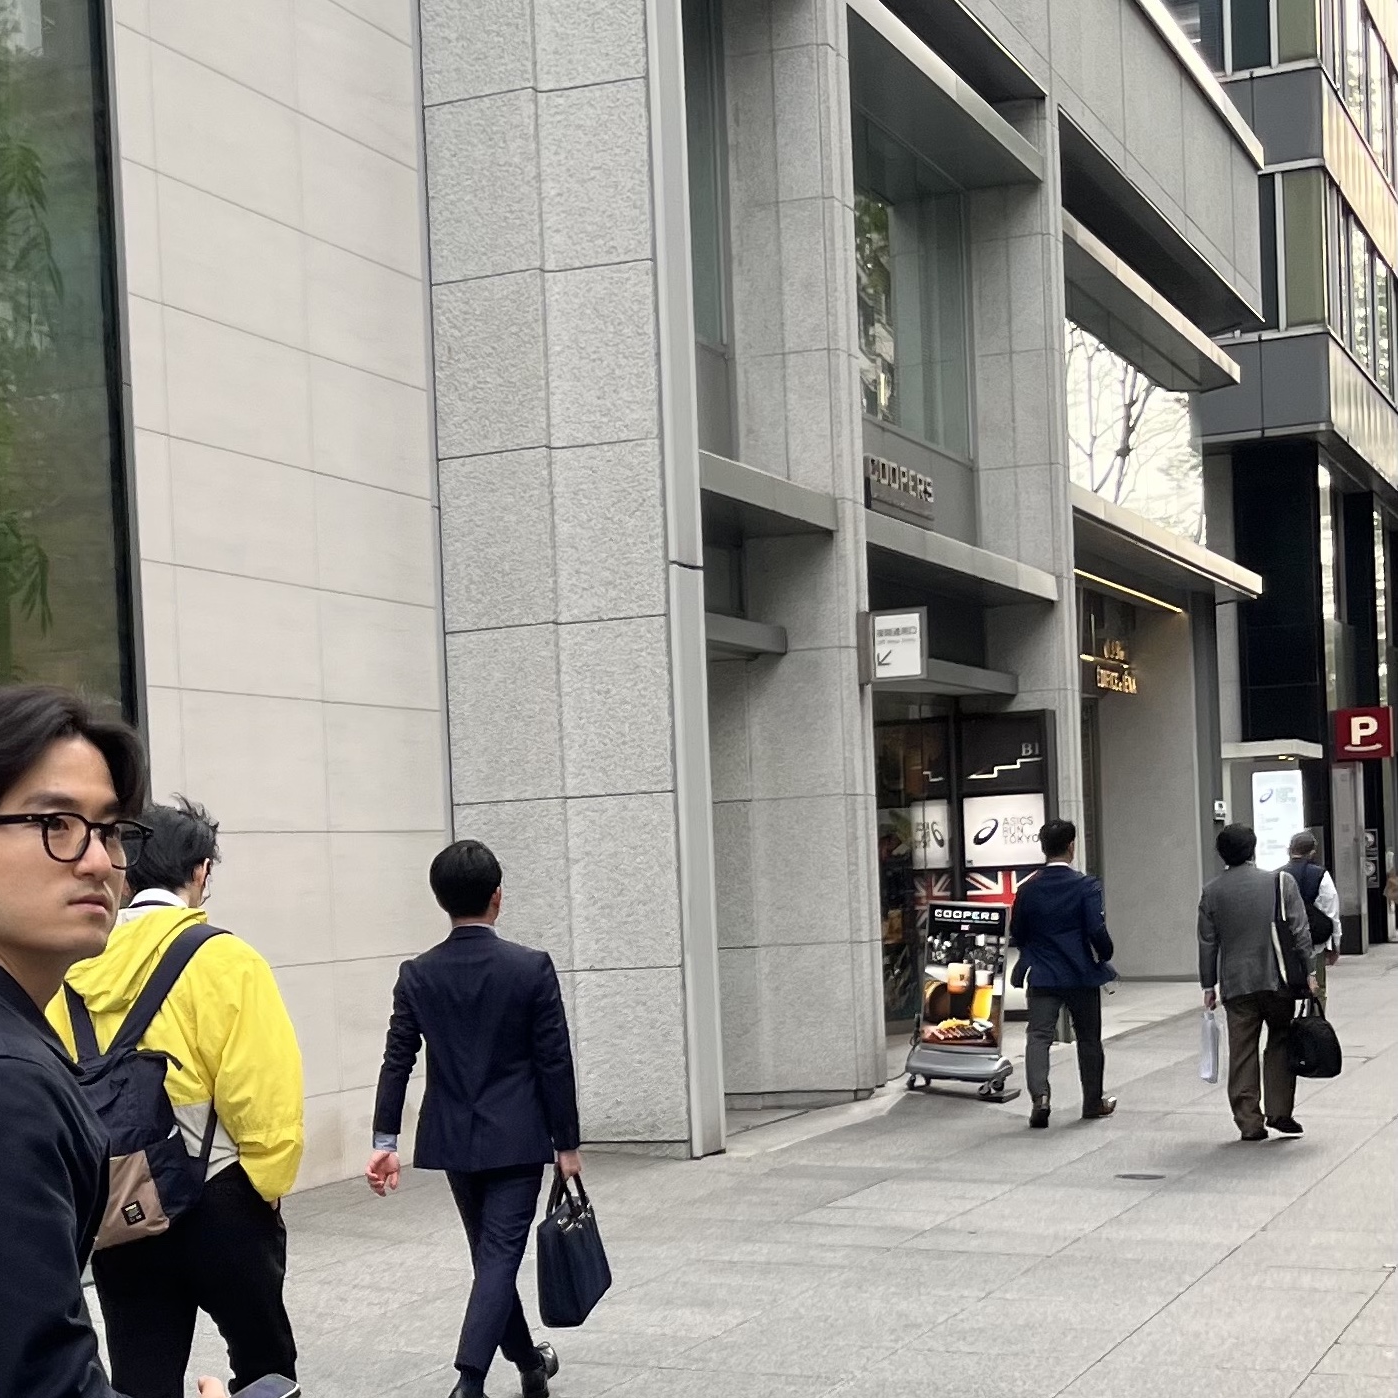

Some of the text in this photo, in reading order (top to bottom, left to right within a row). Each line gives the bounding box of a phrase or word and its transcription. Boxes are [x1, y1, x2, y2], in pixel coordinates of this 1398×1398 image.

[869, 455, 934, 503] COOPERS
[1350, 715, 1379, 746] P
[1002, 816, 1034, 826] ASICS
[1002, 825, 1024, 835] RUN
[1002, 833, 1040, 845] TOKYO
[934, 908, 1000, 921] COOPERS
